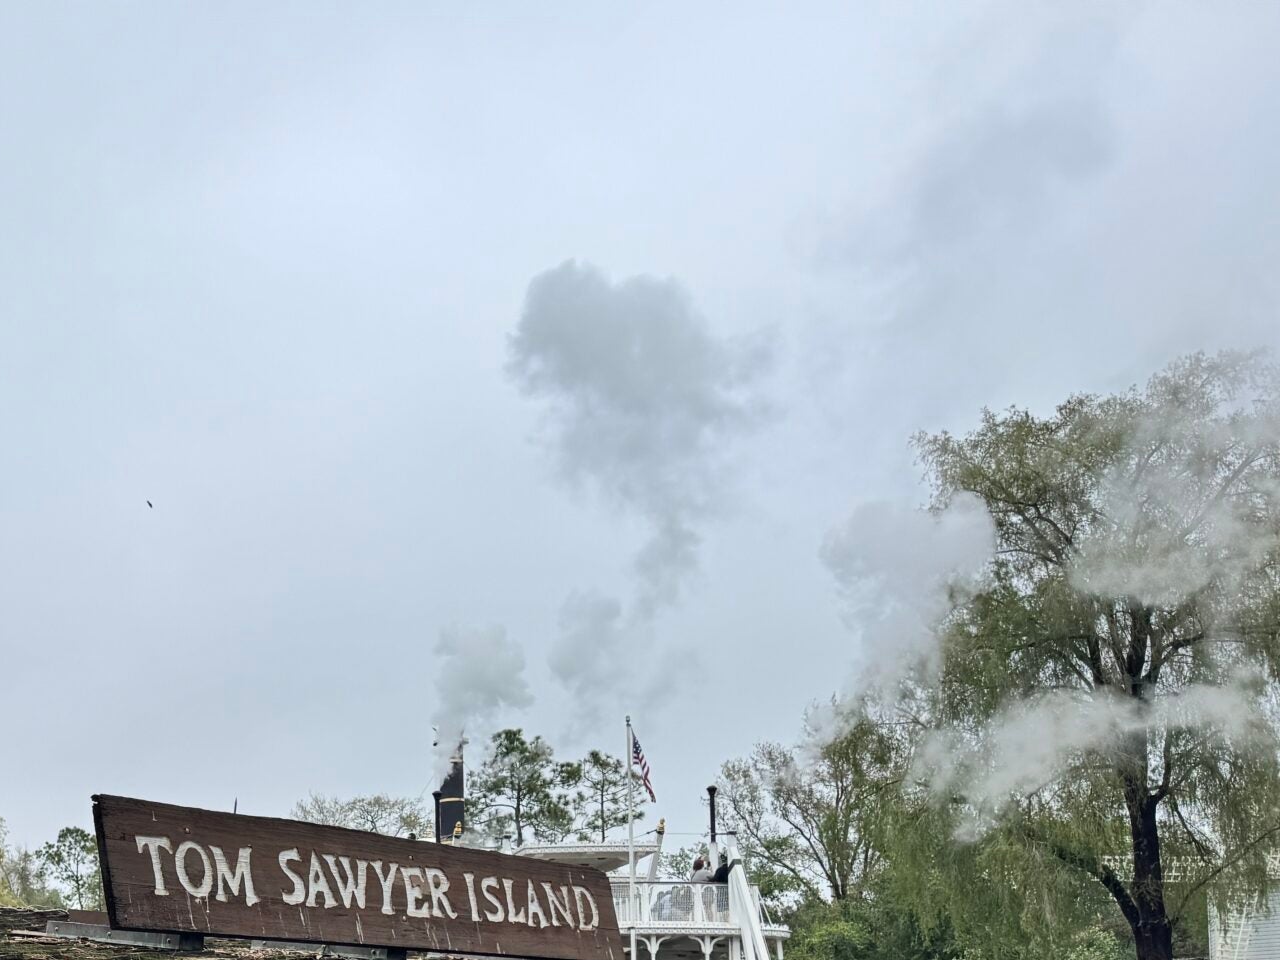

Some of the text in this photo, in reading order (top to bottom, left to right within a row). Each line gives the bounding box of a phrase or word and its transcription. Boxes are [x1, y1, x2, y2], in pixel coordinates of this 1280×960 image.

[135, 835, 599, 931] TOM SAWYER ISLAND
